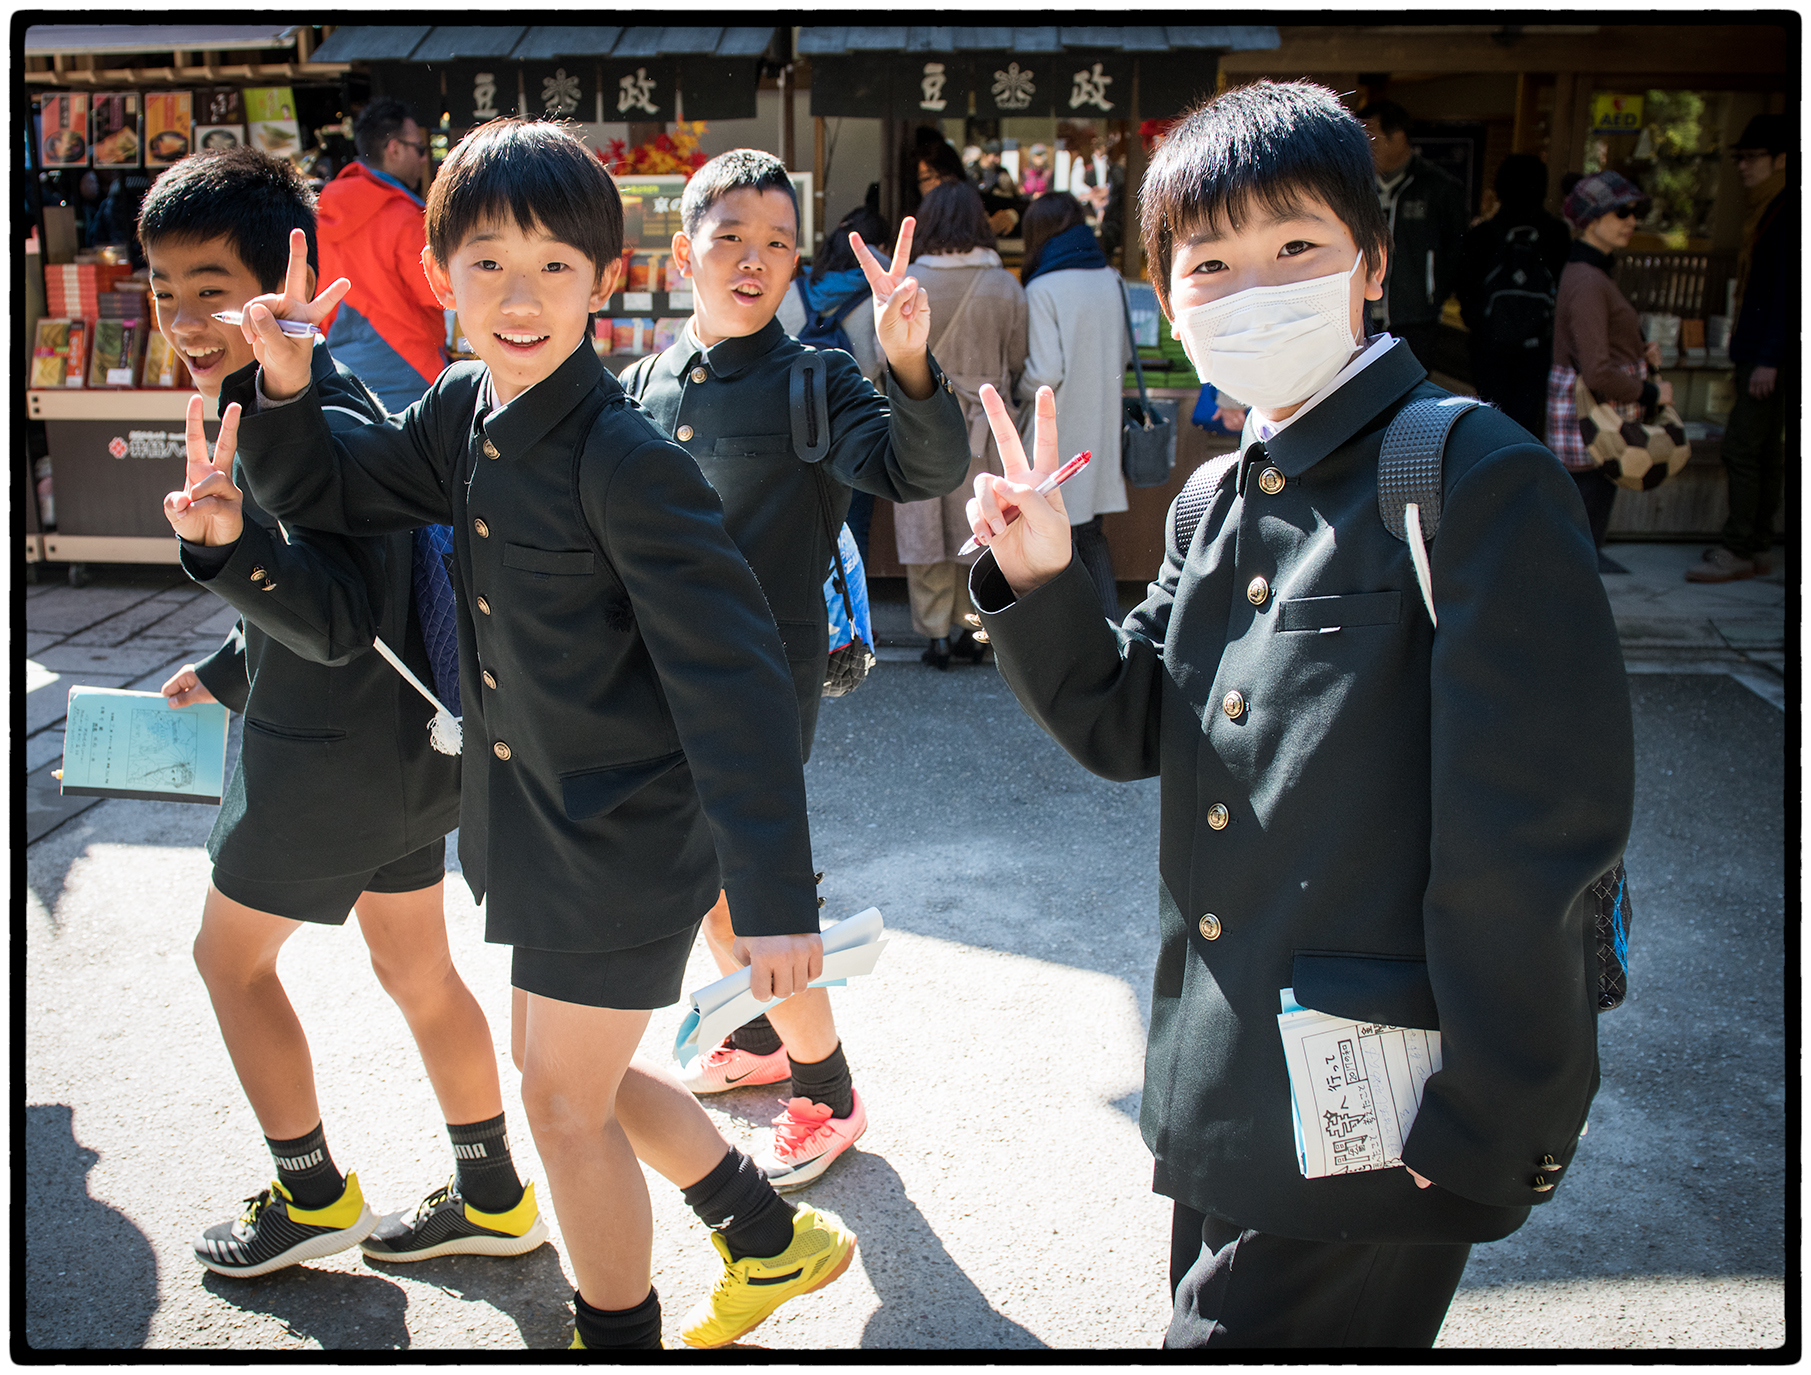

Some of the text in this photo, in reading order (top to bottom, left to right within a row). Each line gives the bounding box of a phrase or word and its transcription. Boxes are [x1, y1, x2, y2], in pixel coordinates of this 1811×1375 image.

[472, 67, 660, 119] 豆 政
[919, 62, 1115, 112] 豆 政
[1600, 112, 1638, 127] AED
[454, 1142, 488, 1160] MA
